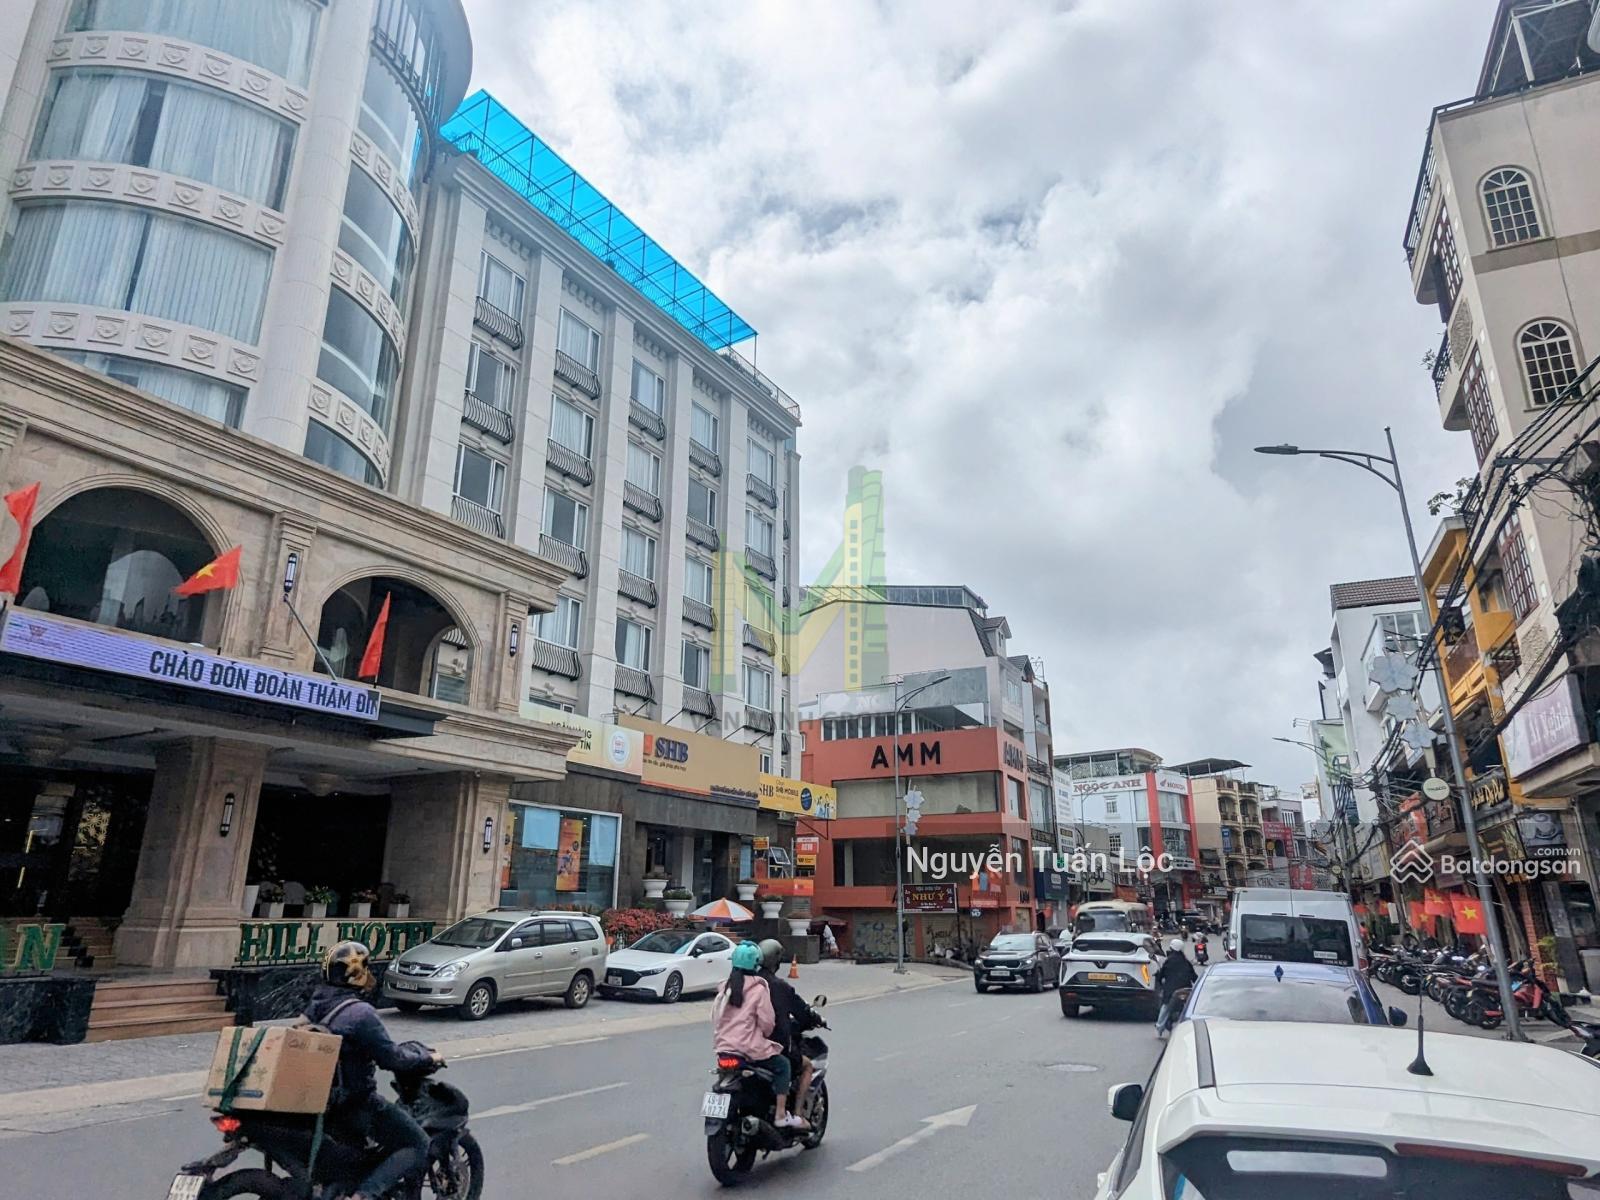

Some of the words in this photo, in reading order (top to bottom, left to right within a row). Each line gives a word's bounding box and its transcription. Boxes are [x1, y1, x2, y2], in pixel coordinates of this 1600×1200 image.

[150, 650, 204, 683] CHÀO
[254, 672, 303, 702] ĐOÀN
[655, 737, 689, 763] SHB
[871, 741, 941, 769] AMM
[1112, 778, 1142, 790] ANH
[0, 922, 66, 973] N
[236, 921, 328, 963] HILL
